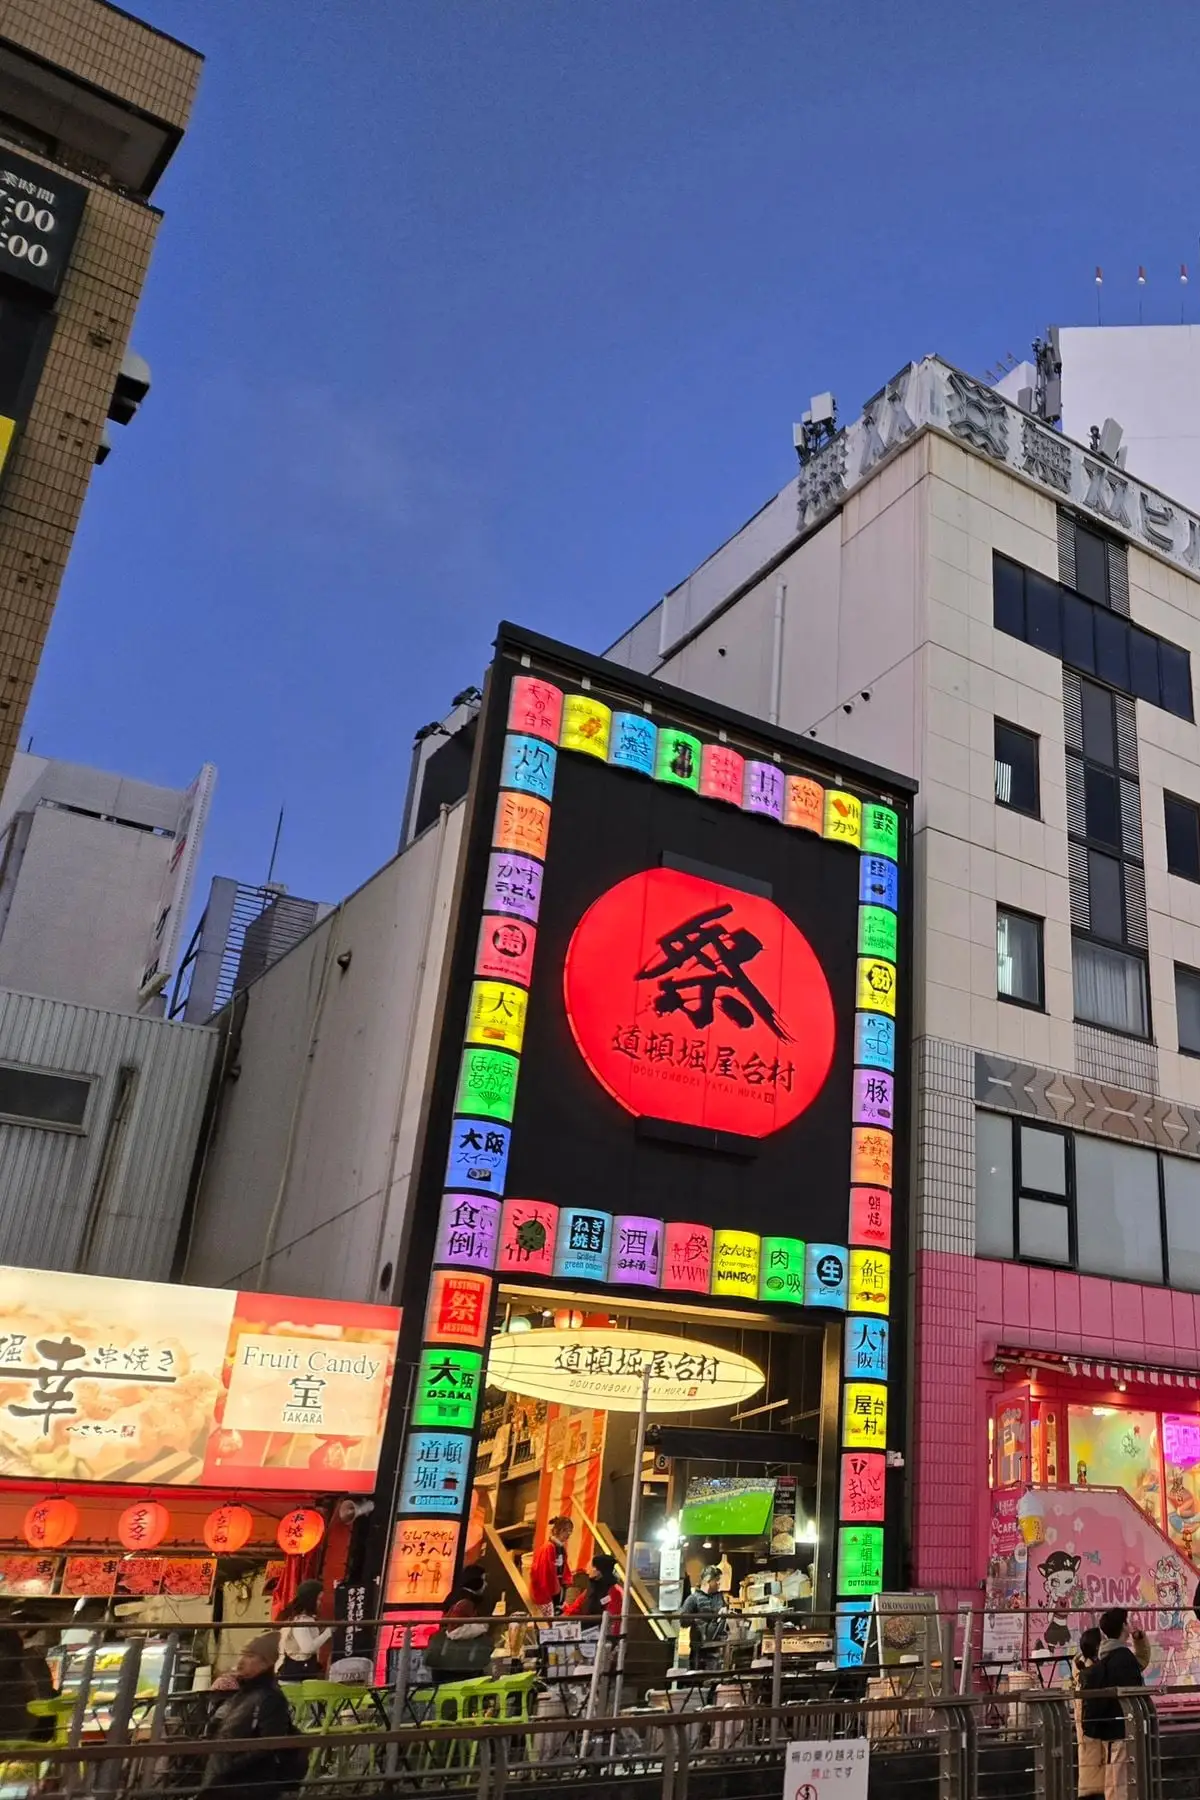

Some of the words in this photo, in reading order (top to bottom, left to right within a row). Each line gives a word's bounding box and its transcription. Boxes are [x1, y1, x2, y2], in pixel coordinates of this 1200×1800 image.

[528, 684, 555, 703] 天下
[534, 702, 546, 713] の
[505, 799, 545, 829] ミックス
[503, 820, 544, 845] ジュース
[833, 820, 858, 837] カツ
[498, 862, 539, 885] かす
[495, 882, 536, 900] うどん
[633, 903, 798, 1046] 祭
[470, 1055, 513, 1078] ほんま
[611, 1023, 795, 1093] 道頓堀屋台村
[468, 1073, 512, 1095] あかん
[865, 1078, 889, 1104] 豚
[459, 1128, 506, 1157] 大阪
[456, 1152, 501, 1168] スイーツ
[573, 1217, 605, 1233] ねぎ
[571, 1232, 601, 1250] 焼き
[619, 1227, 648, 1257] 酒
[770, 1249, 790, 1270] 肉
[822, 1259, 841, 1283] 生
[819, 1287, 842, 1296] ビール
[448, 1291, 478, 1321] 祭
[93, 1343, 175, 1373] 串焼き
[853, 1324, 877, 1369] 大阪
[243, 1345, 300, 1370] Fruit
[308, 1350, 381, 1381] Candy
[427, 1357, 476, 1390] 大阪
[555, 1345, 720, 1385] 道頓堀屋台村
[286, 1374, 327, 1411] 宝
[426, 1389, 472, 1402] OSAKA
[635, 1384, 664, 1395] YTAI
[853, 1395, 885, 1416] 屋台
[281, 1410, 324, 1425] TAKARA
[863, 1418, 877, 1435] 村
[416, 1440, 464, 1465] 道頓
[414, 1466, 438, 1489] 堀
[997, 1523, 1018, 1534] CAFE
[102, 1560, 117, 1574] 串
[201, 1562, 213, 1577] 串
[1085, 1573, 1141, 1605] PINK
